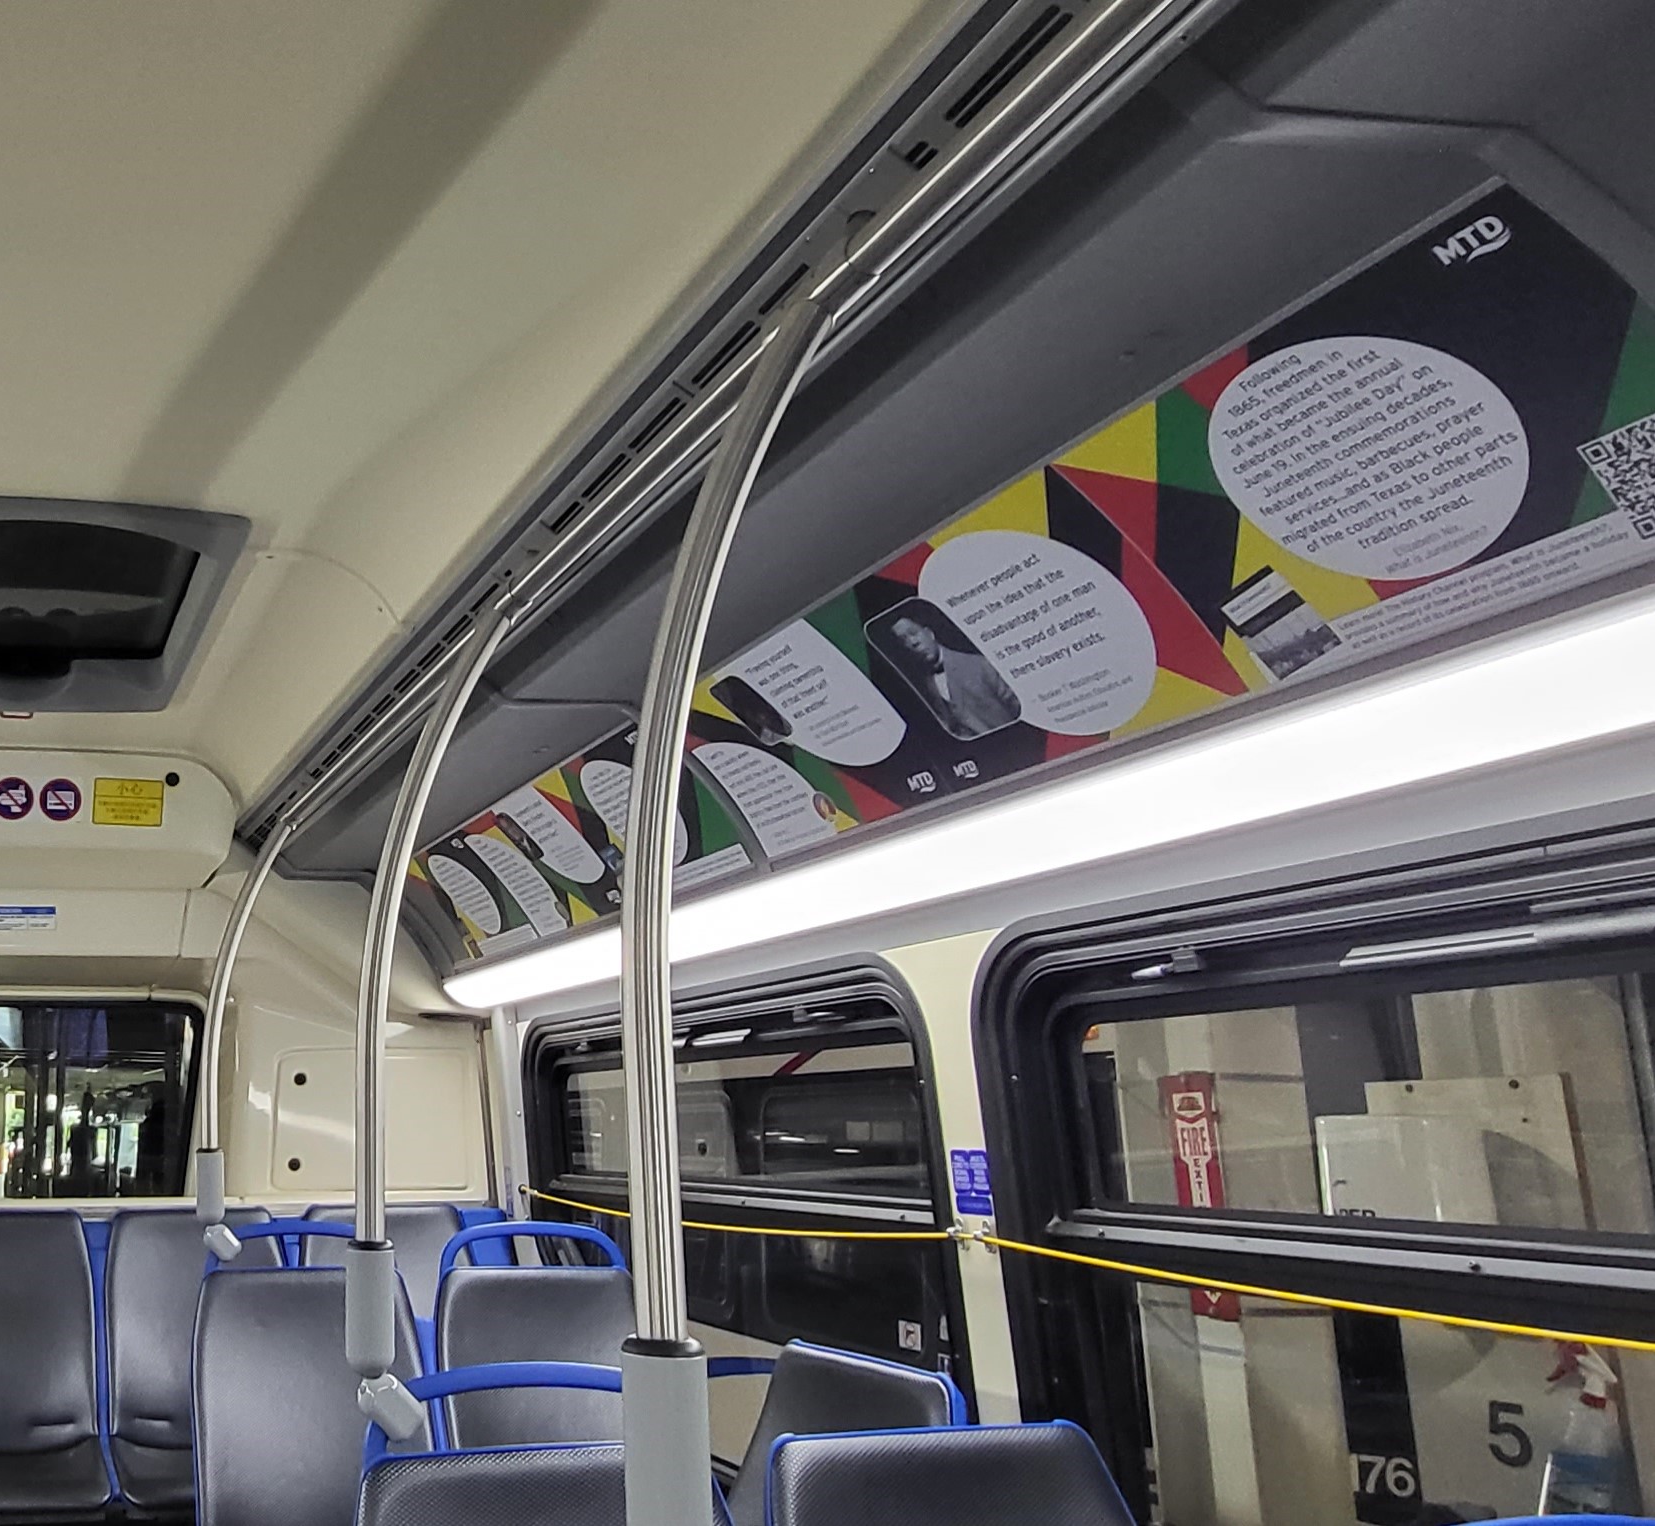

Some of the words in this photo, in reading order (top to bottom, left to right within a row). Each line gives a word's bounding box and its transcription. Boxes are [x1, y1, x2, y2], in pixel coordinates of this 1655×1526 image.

[1432, 216, 1510, 265] MTD
[1222, 419, 1260, 440] Texas
[1259, 381, 1323, 421] organized
[1322, 367, 1347, 386] the
[1346, 349, 1381, 371] first
[1228, 396, 1266, 418] 1865,
[1262, 360, 1327, 399] freedmen
[1326, 350, 1344, 363] in
[1239, 354, 1302, 392] Following
[1230, 443, 1245, 457] of
[1246, 427, 1278, 449] what
[1275, 400, 1329, 432] became
[1327, 386, 1353, 403] the
[1354, 357, 1403, 390] annual
[1232, 434, 1301, 475] celebration
[1301, 424, 1317, 438] of
[1411, 365, 1434, 380] on
[1244, 469, 1273, 489] June
[1271, 459, 1293, 472] 19.
[1290, 451, 1307, 464] In
[1305, 440, 1331, 455] the
[1331, 411, 1387, 443] ensuing
[1386, 379, 1453, 415] decades,
[1259, 486, 1314, 517] featured
[1314, 467, 1358, 491] music,
[1356, 430, 1436, 470] barbecues,
[1435, 401, 1486, 434] prayer
[1263, 458, 1334, 498] Juneteenth
[1334, 396, 1456, 461] commemorations
[1372, 471, 1390, 484] as
[1389, 449, 1432, 474] Black
[1432, 425, 1484, 457] people
[1281, 513, 1337, 545] migrated
[1336, 499, 1372, 518] from
[1370, 480, 1412, 504] Texas
[1412, 472, 1430, 485] to
[1431, 452, 1471, 477] other
[1474, 431, 1519, 459] parts
[1306, 539, 1321, 553] of
[1320, 530, 1345, 546] the
[1345, 506, 1398, 536] country
[1399, 495, 1424, 513] the
[1427, 455, 1513, 500] Juneteenth
[1357, 518, 1418, 549] tradition
[1419, 494, 1474, 524] spread.
[946, 580, 990, 608] Whenever
[990, 563, 1023, 587] people
[1022, 553, 1041, 569] act
[964, 609, 986, 626] upon
[985, 600, 1003, 613] the
[1003, 590, 1025, 606] idea
[1023, 577, 1047, 595] that
[1045, 568, 1065, 584] the
[980, 609, 1040, 643] disadvantage
[1039, 601, 1052, 614] of
[1052, 593, 1072, 608] one
[1072, 580, 1097, 598] man
[996, 650, 1006, 661] is
[1004, 641, 1022, 657] the
[1022, 630, 1047, 650] good
[1046, 623, 1058, 637] of
[1010, 660, 1037, 679] there
[1036, 645, 1071, 668] slavery
[907, 771, 936, 793] MTD
[953, 760, 980, 778] MTD
[1179, 1126, 1208, 1156] FIRE
[1488, 1400, 1533, 1467] 5
